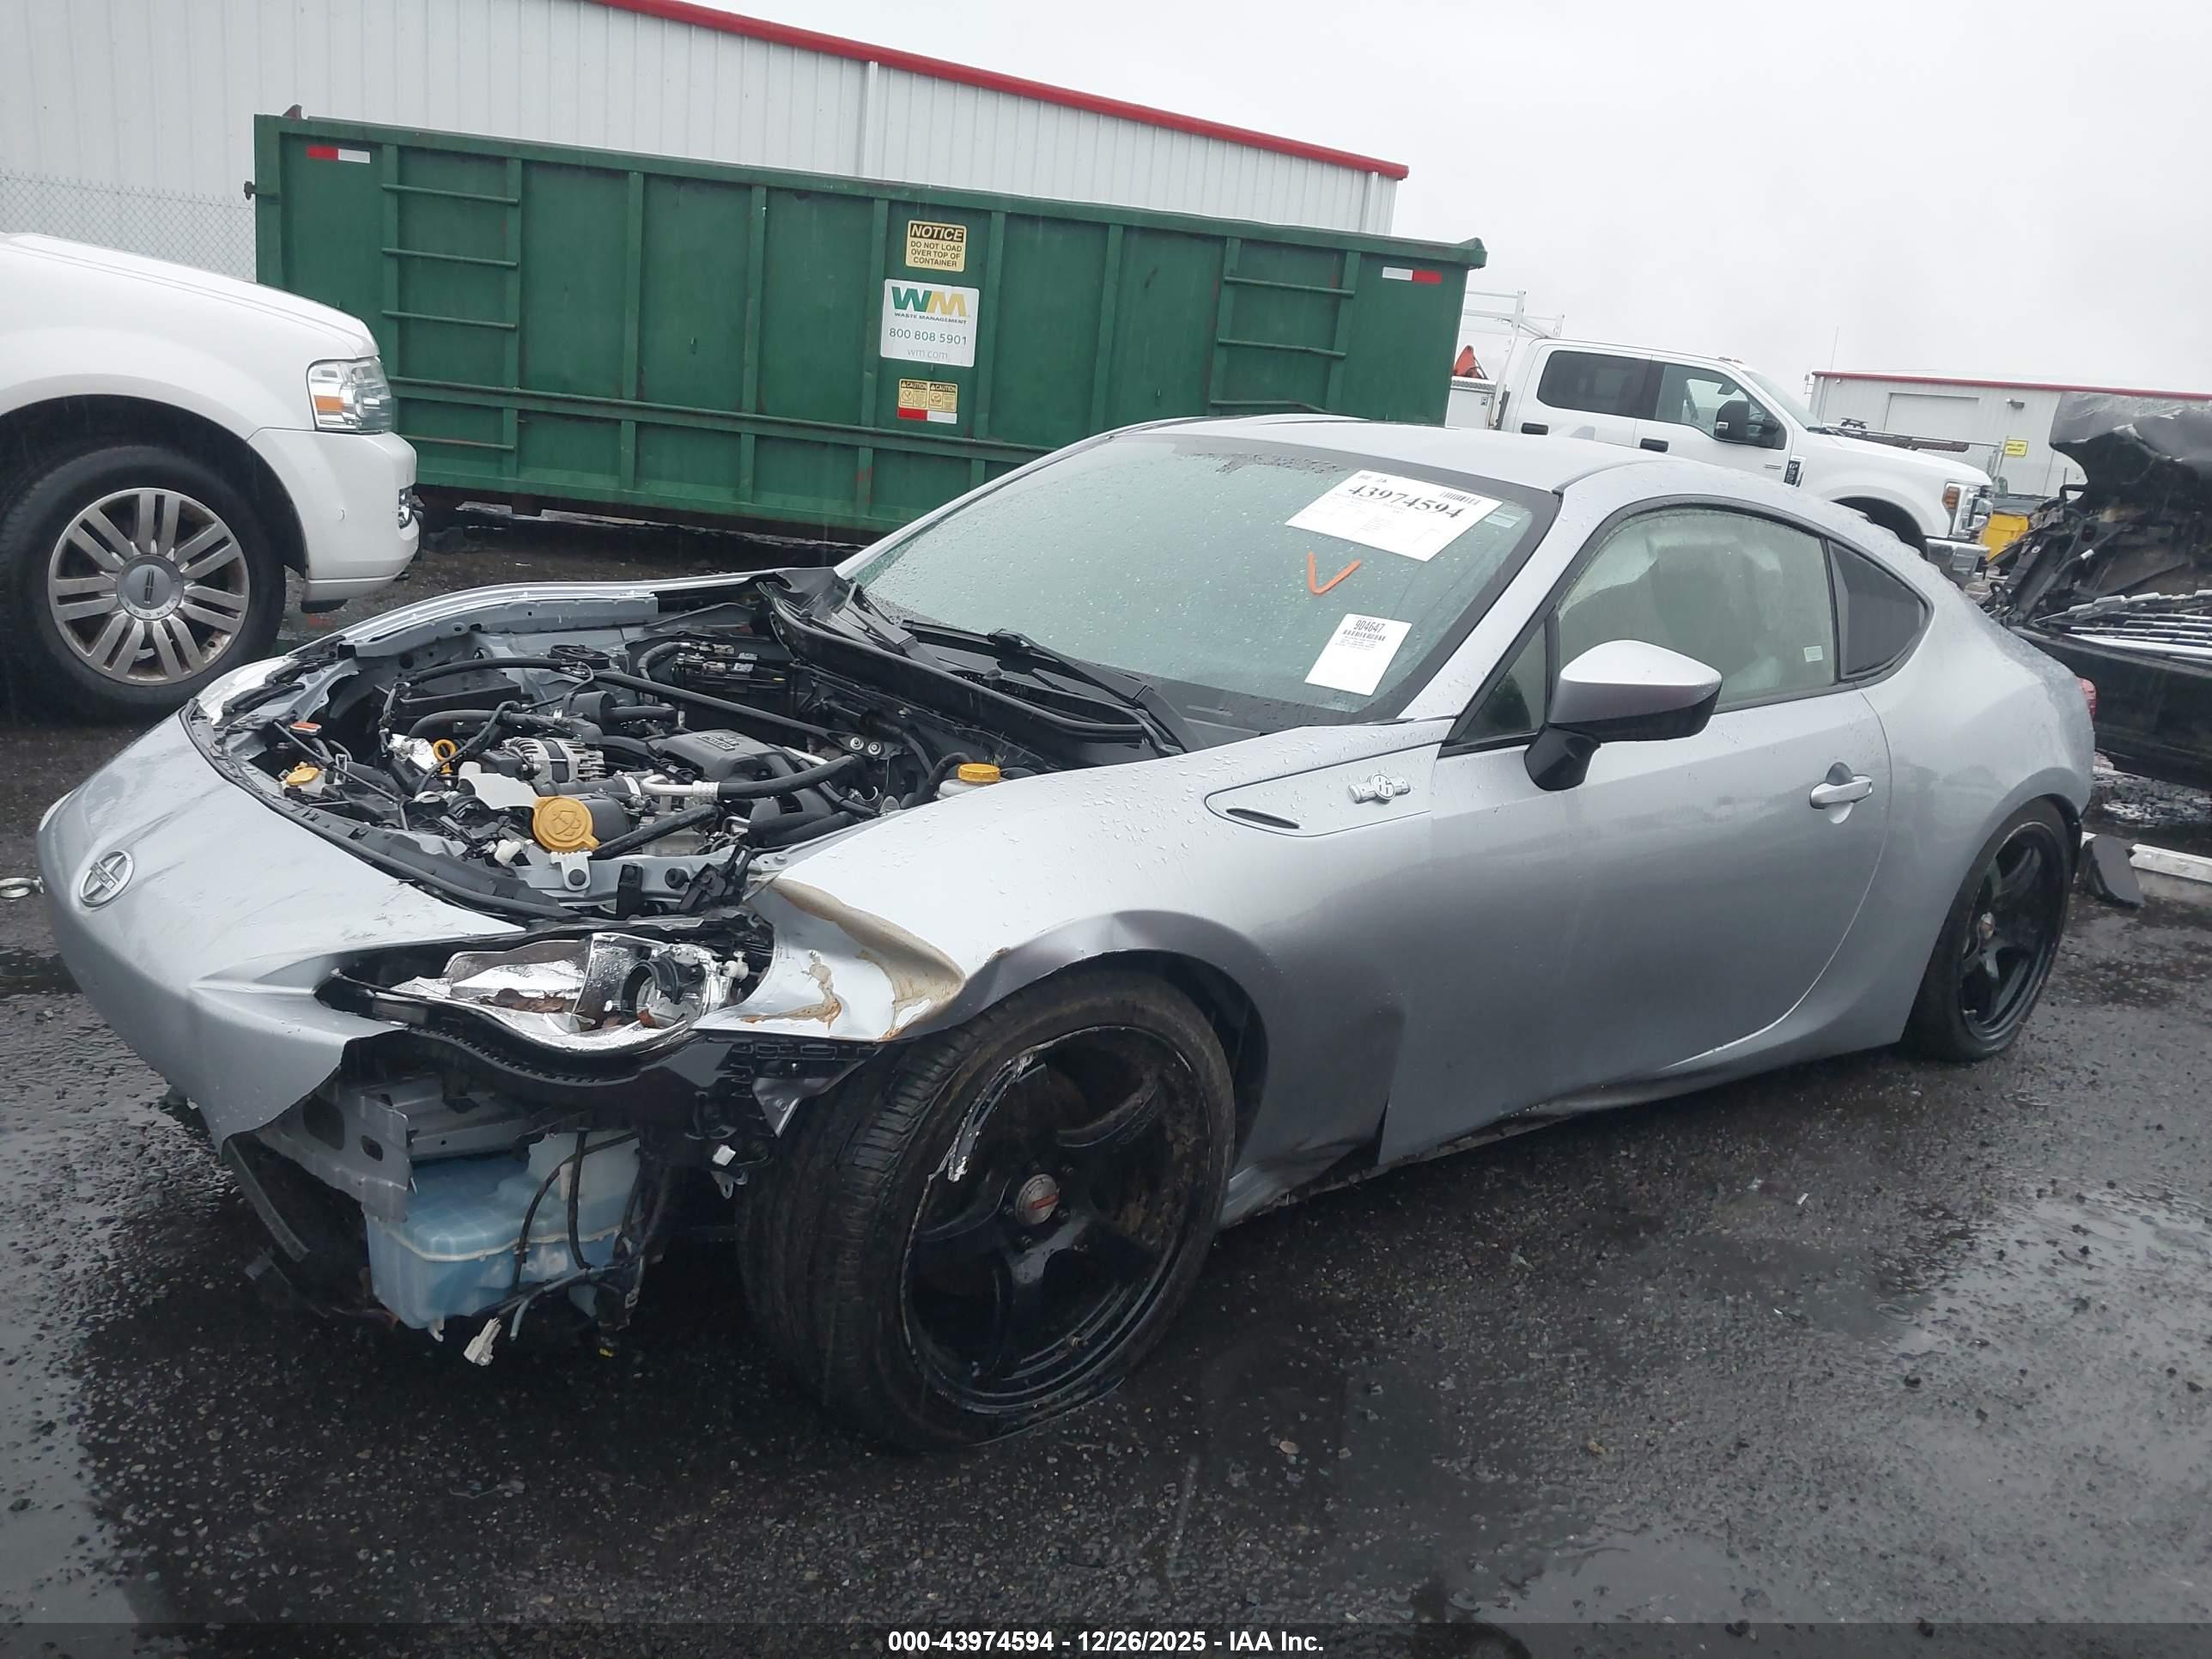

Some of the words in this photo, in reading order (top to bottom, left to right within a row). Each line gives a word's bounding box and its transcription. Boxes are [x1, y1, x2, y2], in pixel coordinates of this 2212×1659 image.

[911, 224, 963, 241] NOTICE
[914, 256, 957, 267] CONTAINER
[891, 286, 967, 317] WM
[919, 314, 967, 325] MANAGEMENT
[890, 327, 910, 338] 800
[915, 330, 936, 342] 808
[939, 332, 967, 345] 5901
[908, 349, 948, 360] wm.com
[907, 381, 927, 390] CAUTION
[935, 384, 957, 392] CAUTION
[1348, 483, 1465, 519] 43974594
[1353, 619, 1387, 634] 904647
